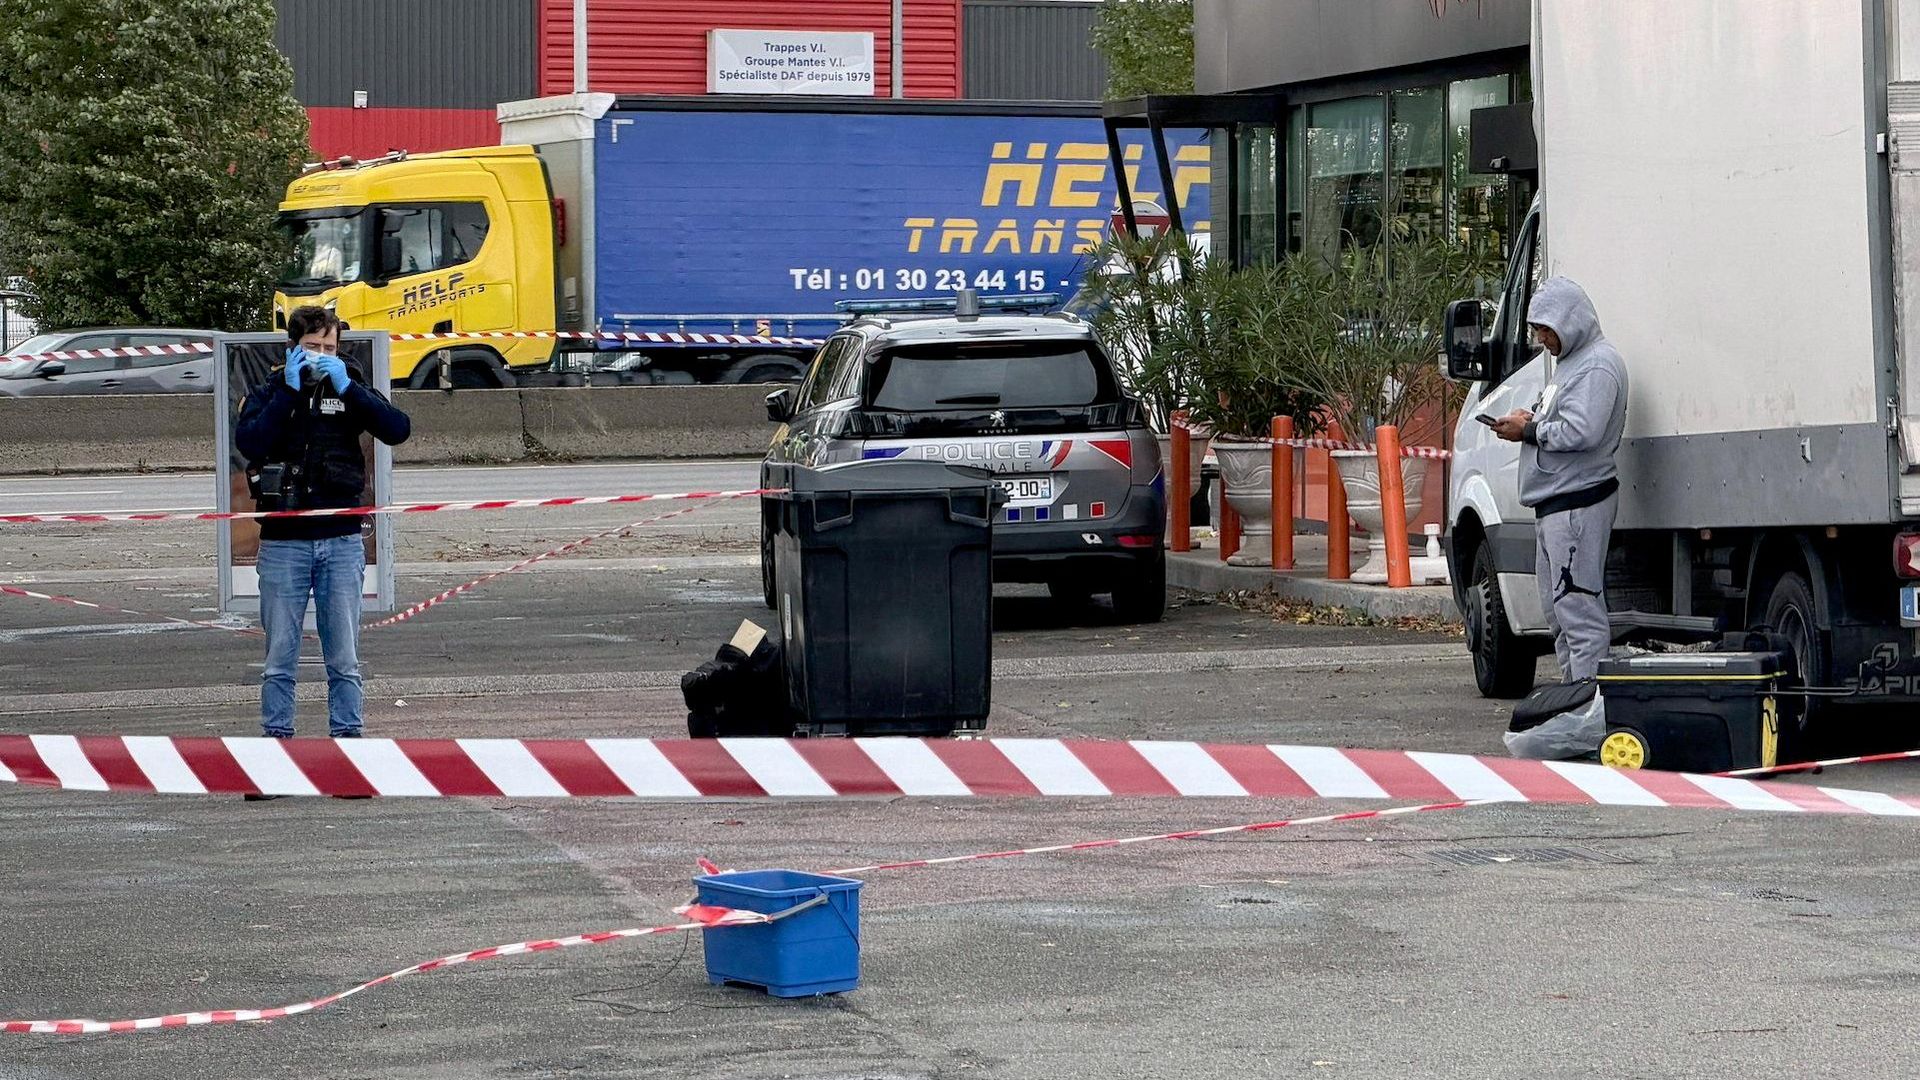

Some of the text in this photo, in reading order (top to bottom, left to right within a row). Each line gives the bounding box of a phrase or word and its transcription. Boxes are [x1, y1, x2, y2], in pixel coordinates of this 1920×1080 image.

[764, 43, 826, 53] Trappes V.I.
[744, 57, 846, 68] Groupe Mantes V.I.
[719, 70, 871, 82] Spécialiste DAF depuis 1979
[403, 272, 465, 305] HELP
[790, 268, 831, 290] Tél
[855, 268, 885, 290] 01
[895, 269, 927, 291] 30
[934, 269, 967, 291] 23
[974, 270, 1006, 291] 44
[1014, 270, 1046, 291] 15
[387, 283, 485, 320] TRANSPORTS
[921, 441, 1032, 461] POLICE
